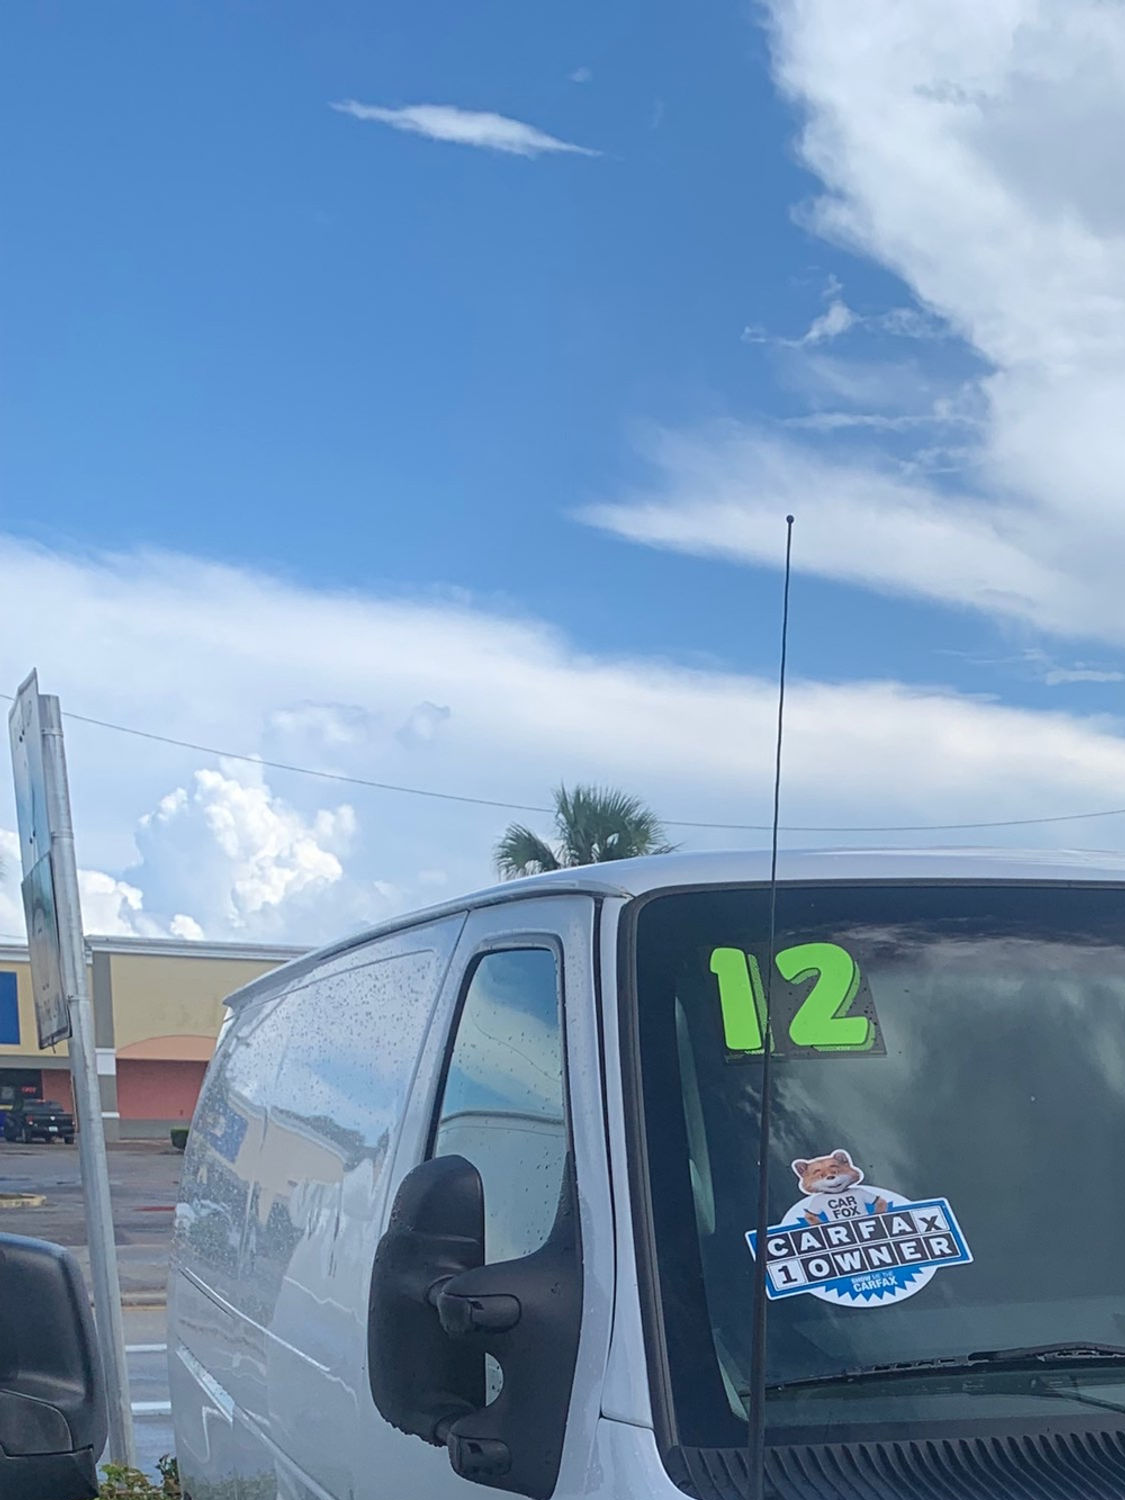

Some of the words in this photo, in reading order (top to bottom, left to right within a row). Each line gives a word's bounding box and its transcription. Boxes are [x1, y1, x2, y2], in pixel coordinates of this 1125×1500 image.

[709, 942, 874, 1051] 12
[828, 1195, 857, 1209] CAR
[832, 1206, 861, 1219] FOX
[766, 1215, 941, 1258] CARFAX
[777, 1265, 798, 1285] 1
[807, 1237, 953, 1277] OWNER
[853, 1276, 898, 1292] CARFAX
